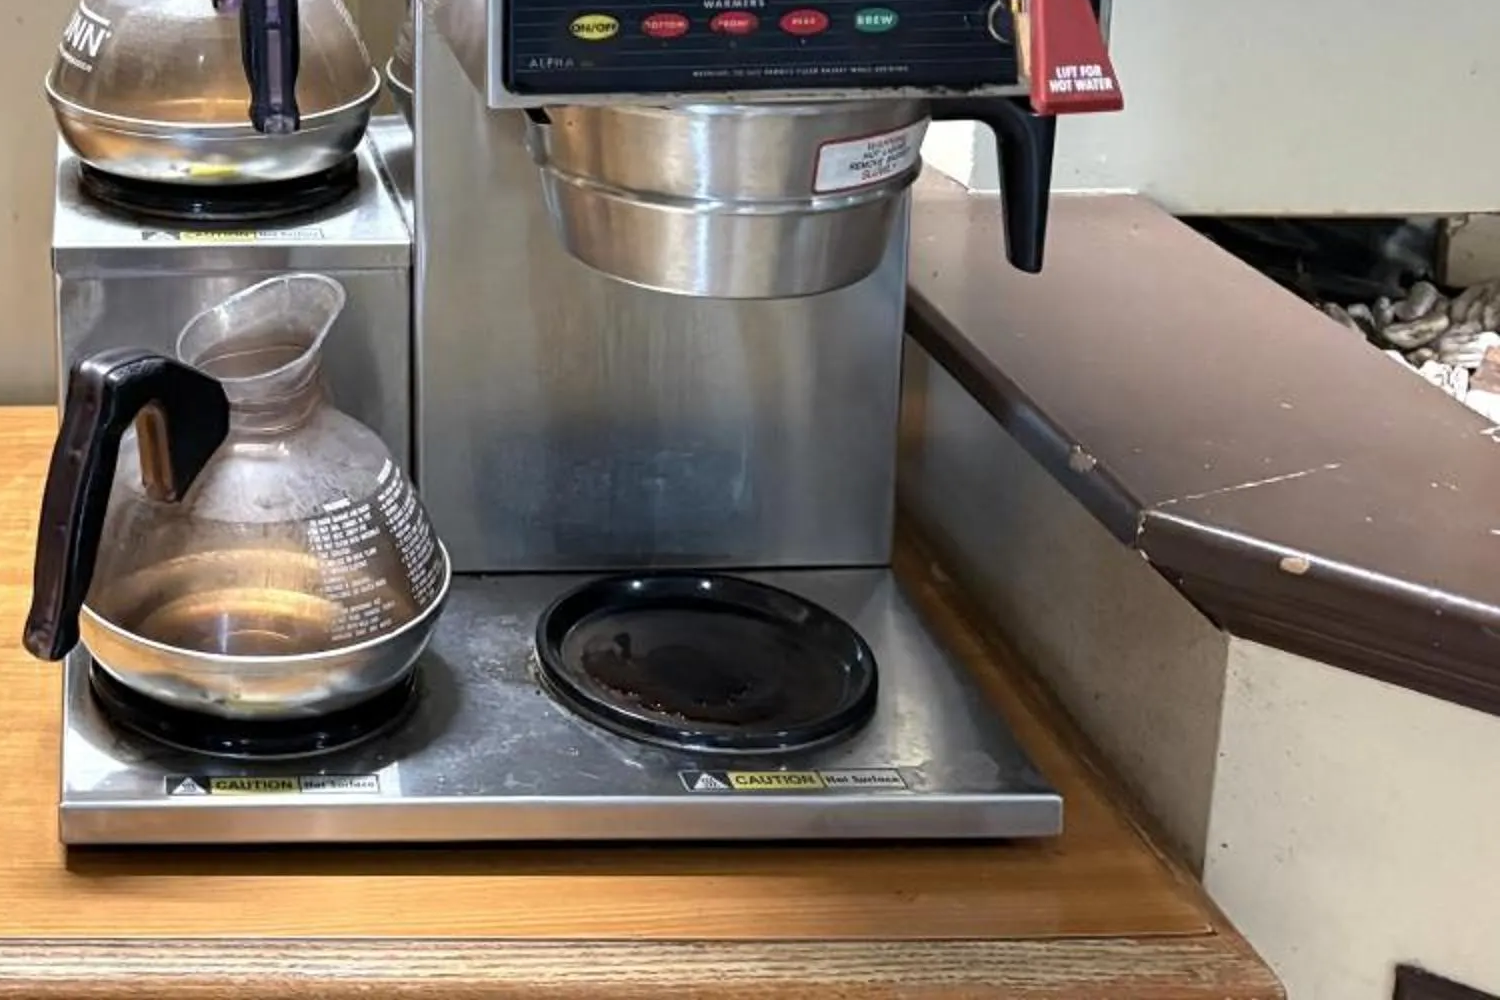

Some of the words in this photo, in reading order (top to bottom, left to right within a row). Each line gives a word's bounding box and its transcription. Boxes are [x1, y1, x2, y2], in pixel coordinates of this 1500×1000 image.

[856, 14, 894, 26] BREW
[571, 22, 617, 34] ON/OFF
[1055, 65, 1078, 79] LIFT
[1080, 63, 1103, 77] FOR
[1049, 79, 1073, 93] HOT
[1074, 77, 1114, 91] WATER
[215, 778, 294, 791] CAUTION
[734, 773, 817, 785] CAUTION
